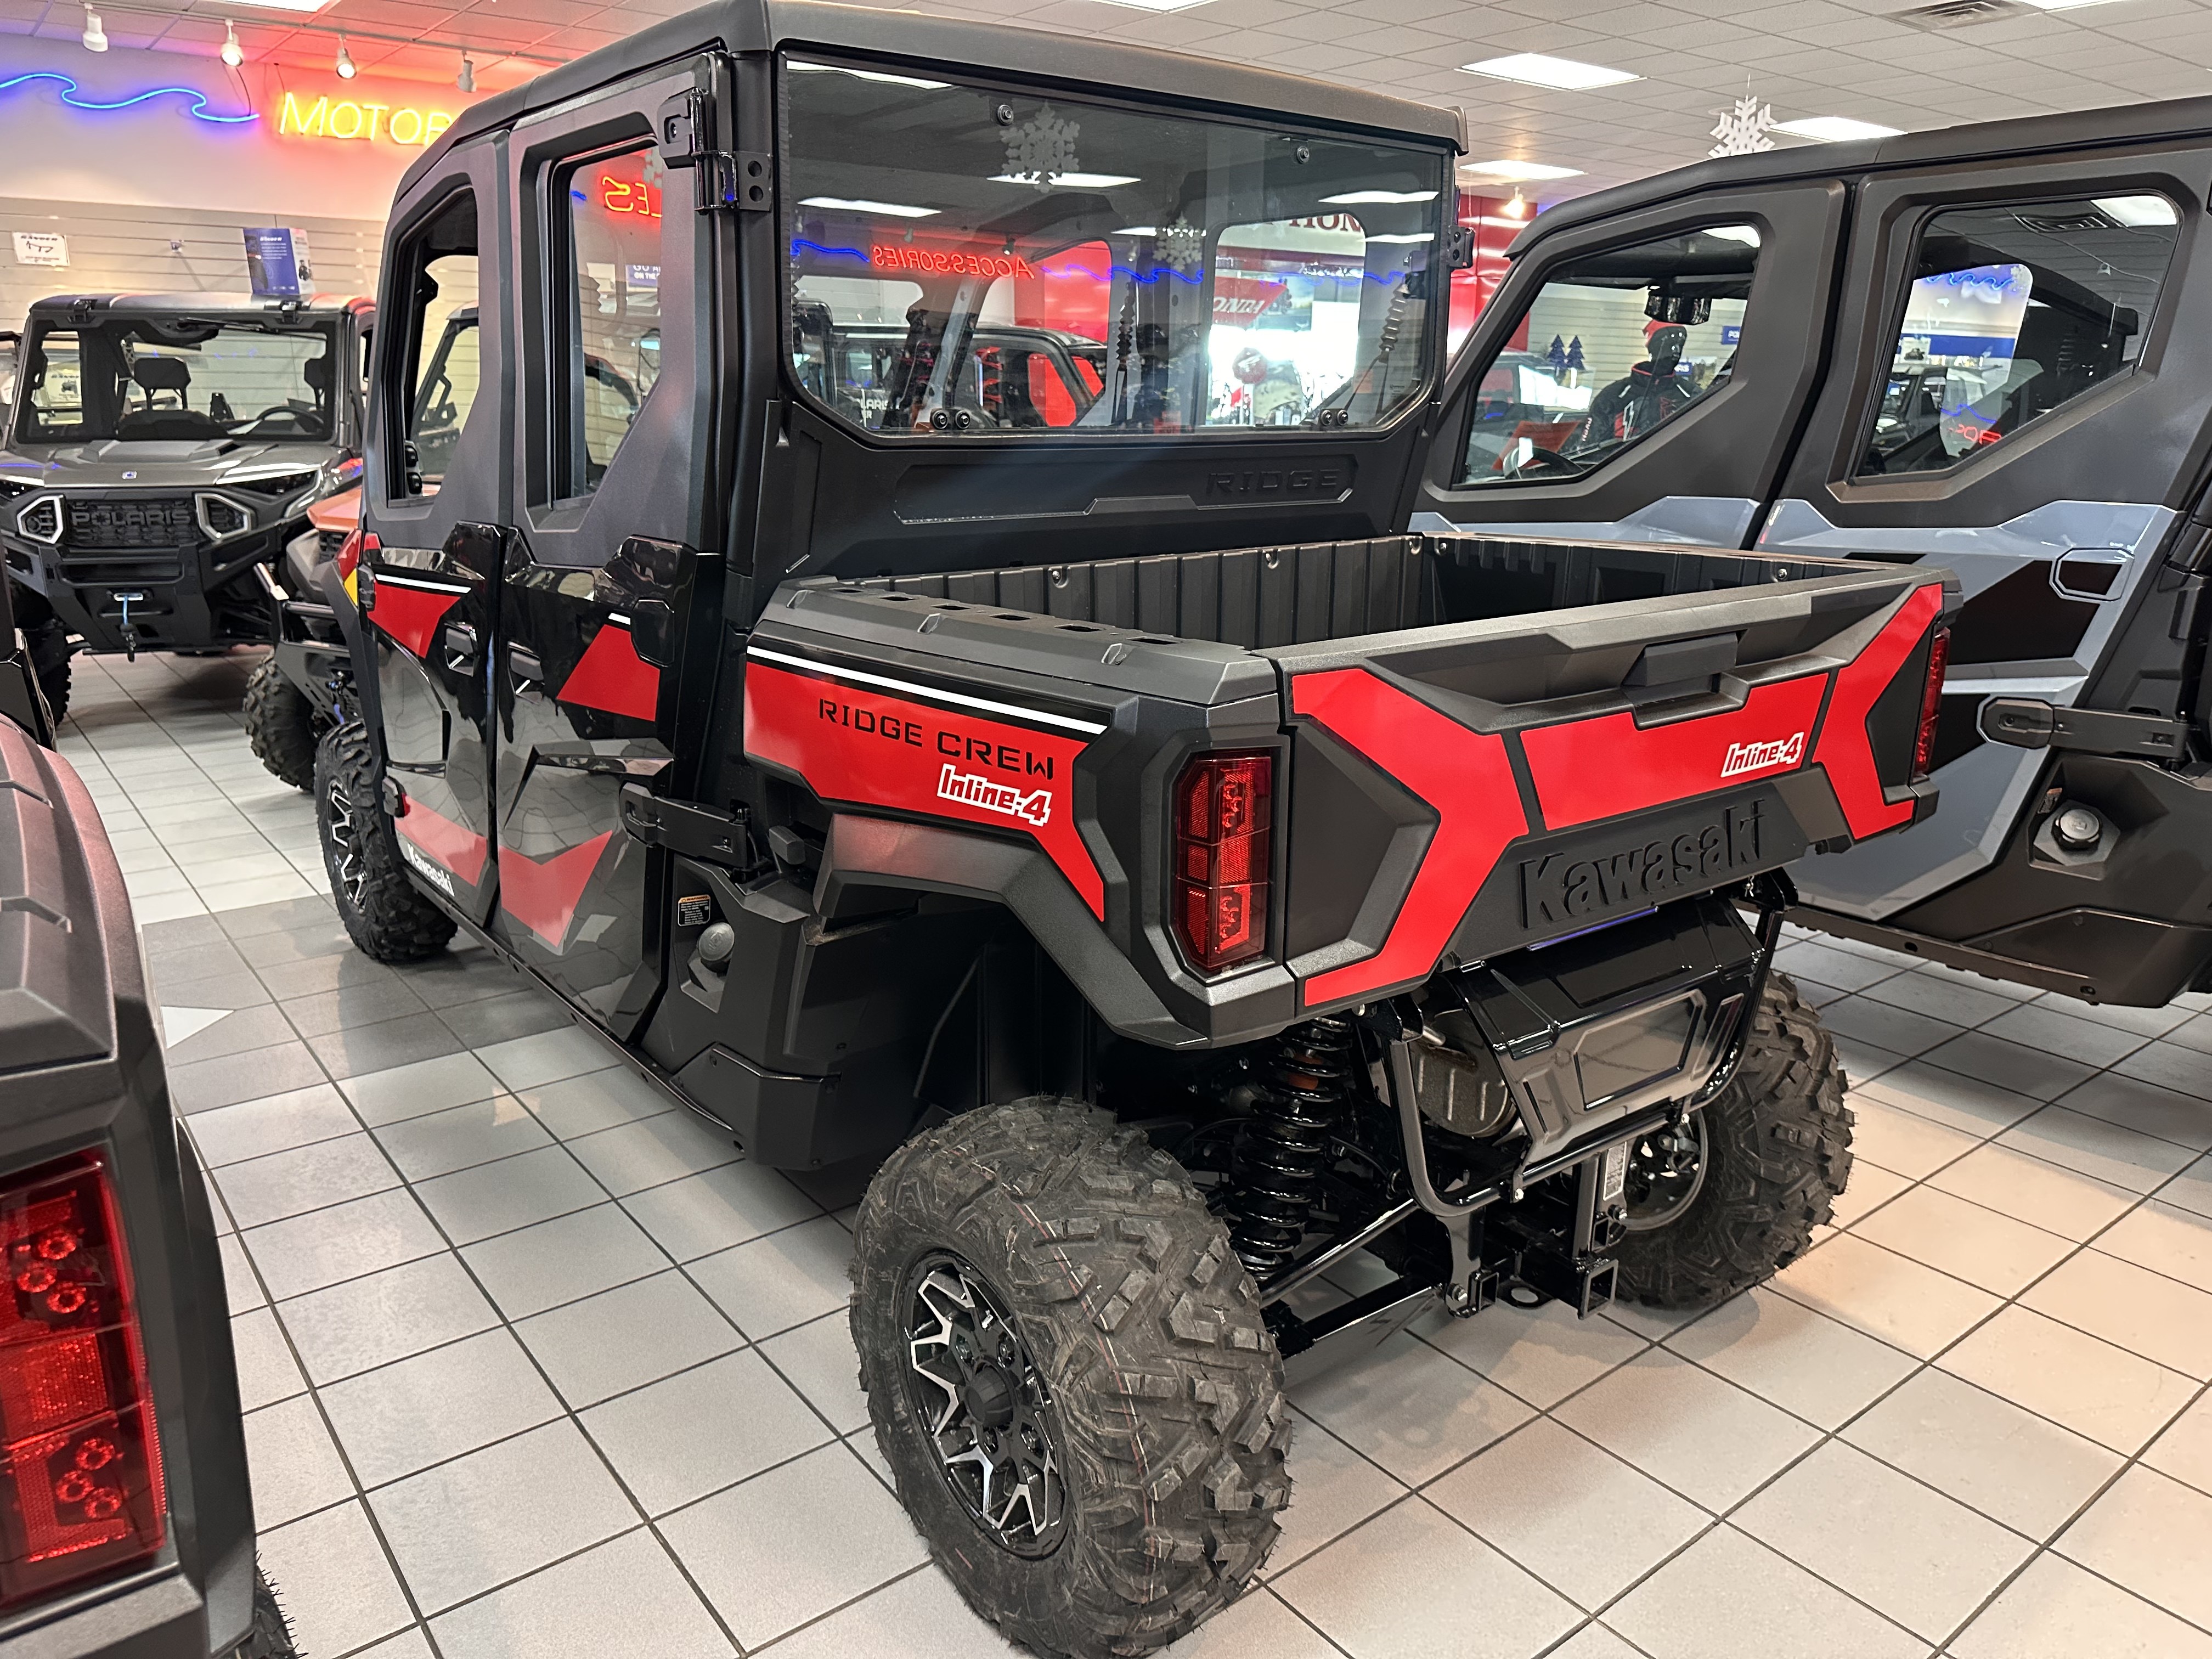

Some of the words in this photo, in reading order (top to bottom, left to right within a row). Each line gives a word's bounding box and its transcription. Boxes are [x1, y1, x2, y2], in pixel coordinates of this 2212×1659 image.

[1206, 469, 1341, 493] RIDGE
[72, 509, 191, 527] POLARIS
[819, 698, 923, 747] RIDGE
[937, 730, 1053, 780] CREW
[1720, 731, 1804, 778] Inline-4
[936, 763, 1052, 827] Inline-4
[408, 843, 455, 897] Kawasaki
[1518, 799, 1766, 930] Kawasaki
